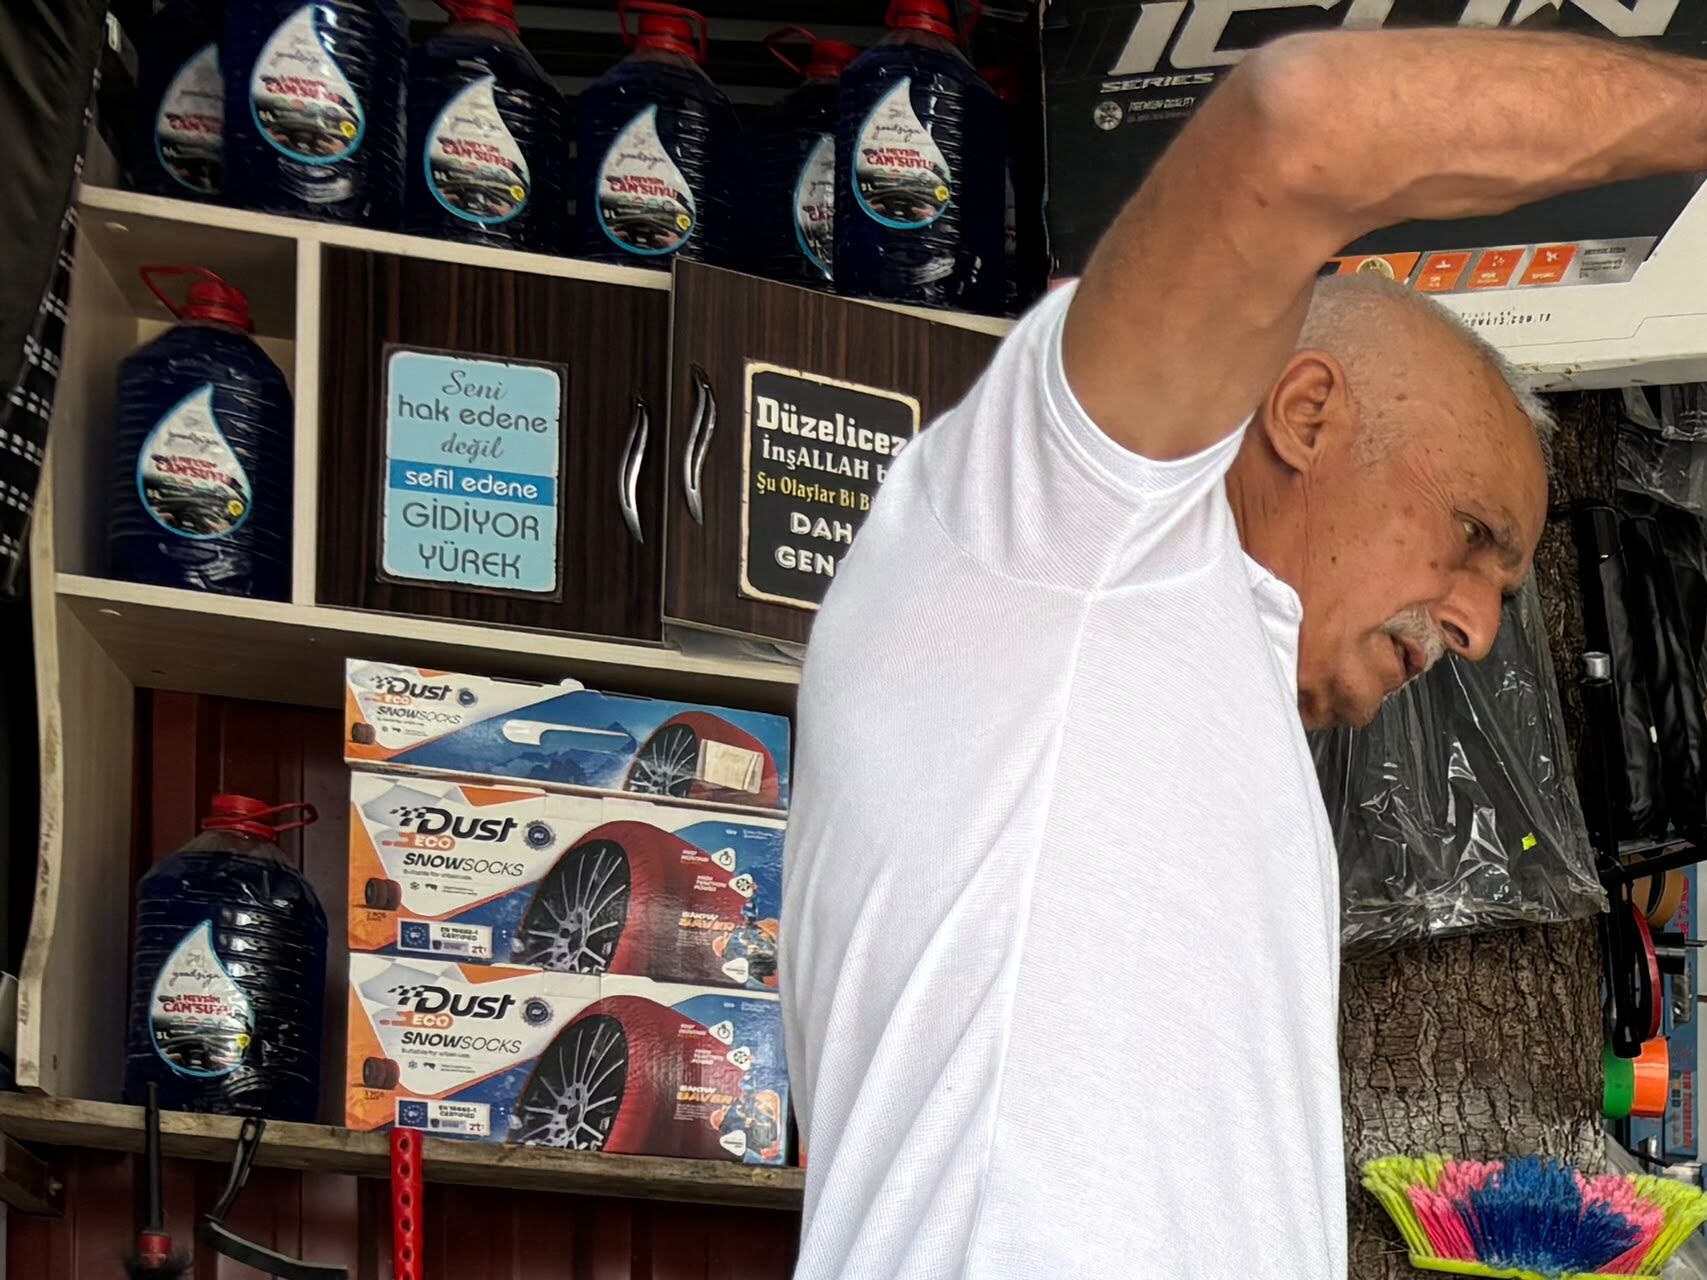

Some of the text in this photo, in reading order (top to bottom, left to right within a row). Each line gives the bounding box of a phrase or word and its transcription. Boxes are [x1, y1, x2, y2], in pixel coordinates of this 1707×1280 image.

[1100, 73, 1214, 93] SERIES
[442, 370, 503, 400] Seni
[398, 394, 548, 433] hak edene
[441, 433, 504, 463] değil
[405, 470, 538, 499] sefil edene
[756, 471, 777, 495] Şu
[780, 476, 836, 504] Olaylar
[402, 498, 540, 541] GİDİYOR
[790, 511, 853, 545] DAH
[419, 540, 521, 579] YÜREK
[774, 545, 836, 577] GEN
[386, 675, 453, 701] Dust
[376, 705, 461, 725] SNOWSOCKS
[416, 806, 518, 843] Dust
[414, 834, 453, 850] ECO
[402, 851, 525, 877] SNOWSOCKS
[413, 985, 515, 1019] Dust
[412, 1013, 448, 1027] ECO
[401, 1030, 522, 1054] SNOWSOCKS
